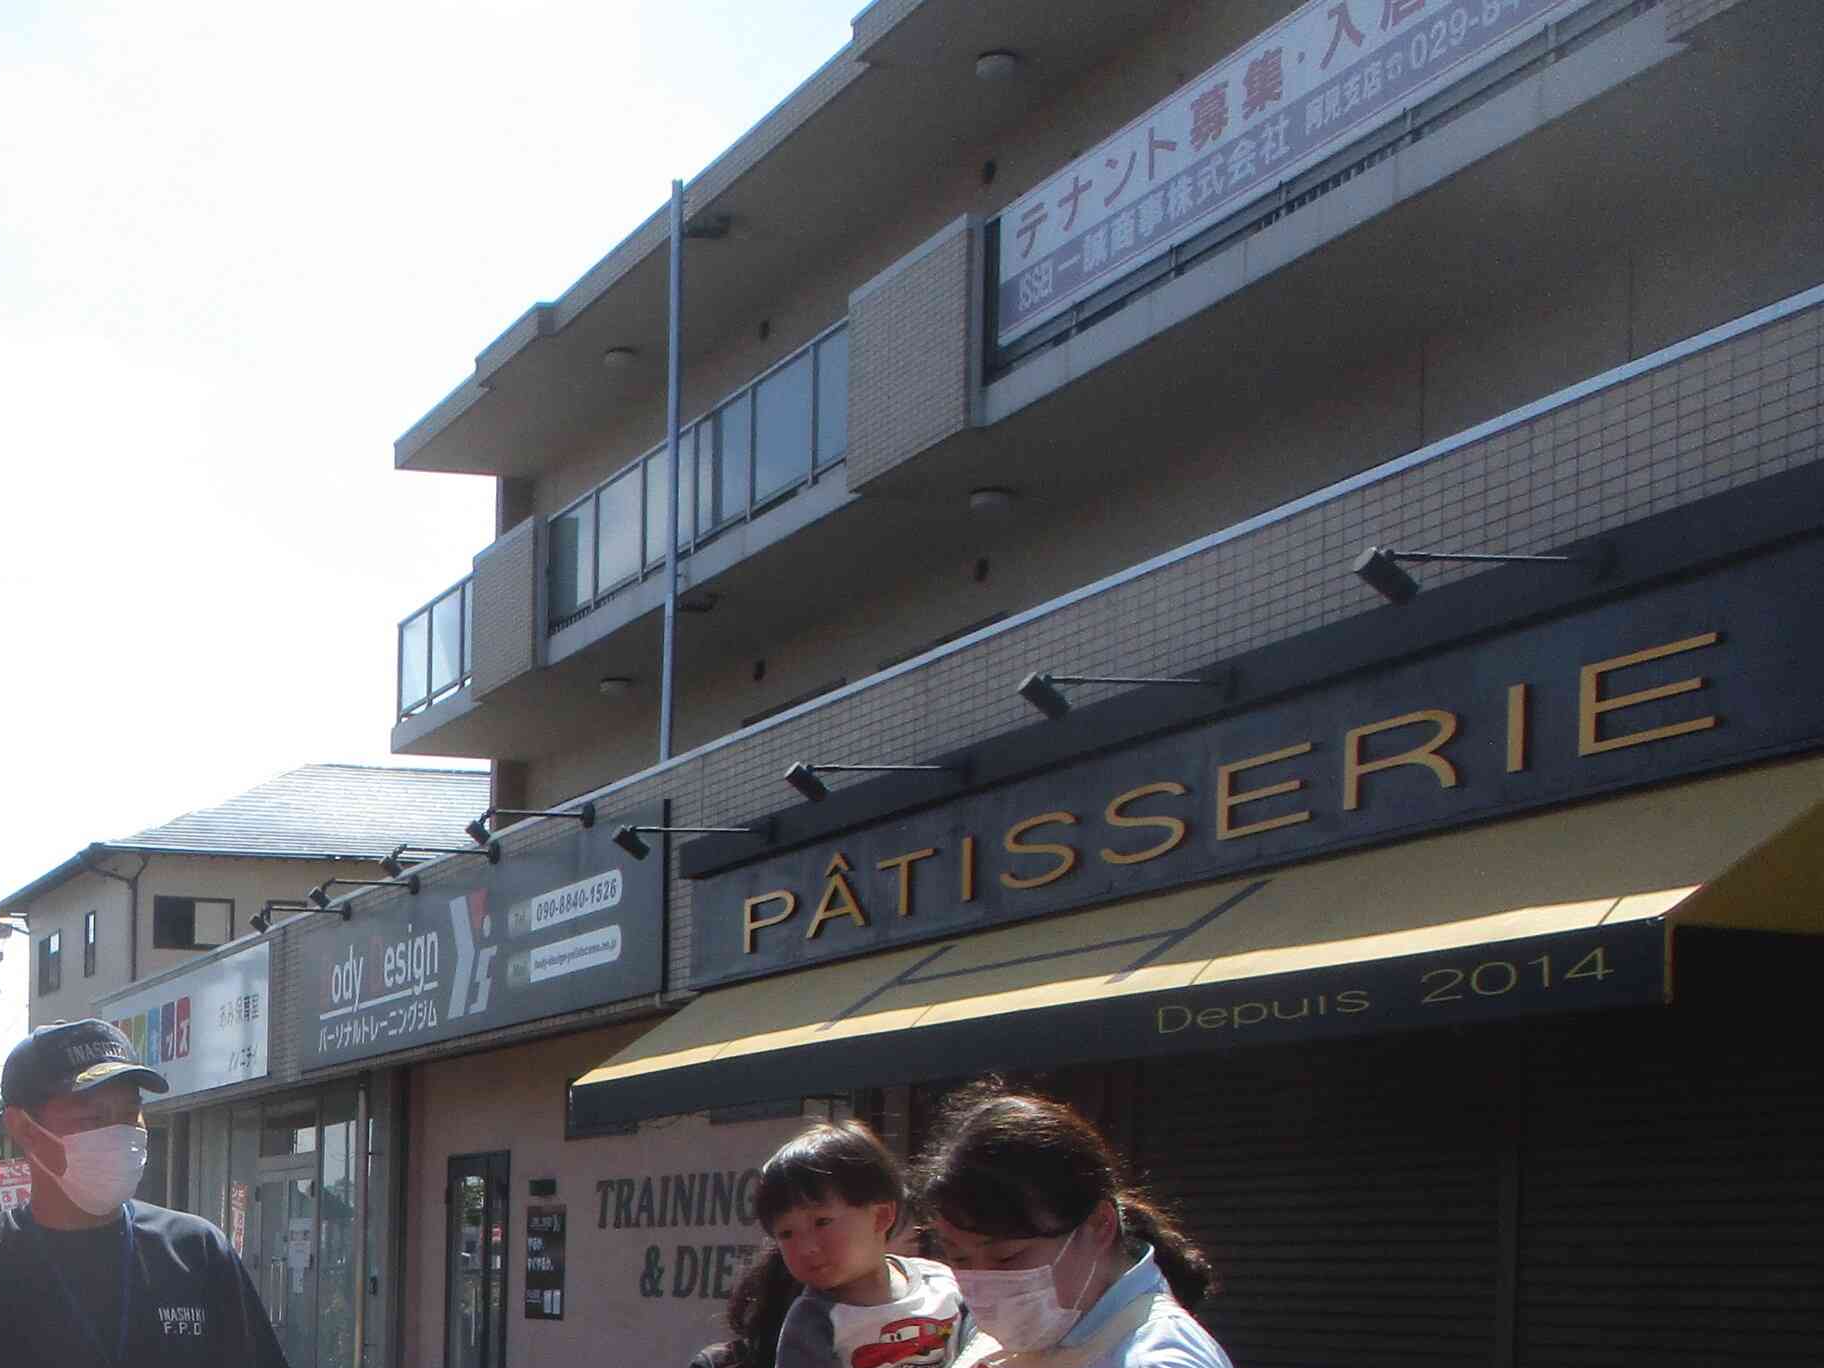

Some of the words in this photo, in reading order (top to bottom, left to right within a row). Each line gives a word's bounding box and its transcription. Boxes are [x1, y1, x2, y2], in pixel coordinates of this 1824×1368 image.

[740, 630, 1721, 955] PÂTISSERIE
[1155, 985, 1372, 1036] Depuis
[1419, 945, 1615, 1006] 2014
[318, 999, 438, 1053] パーソナルトレーニングジム
[595, 1168, 760, 1230] TRAINING
[639, 1244, 665, 1299] &
[157, 1306, 207, 1322] INASHIKI
